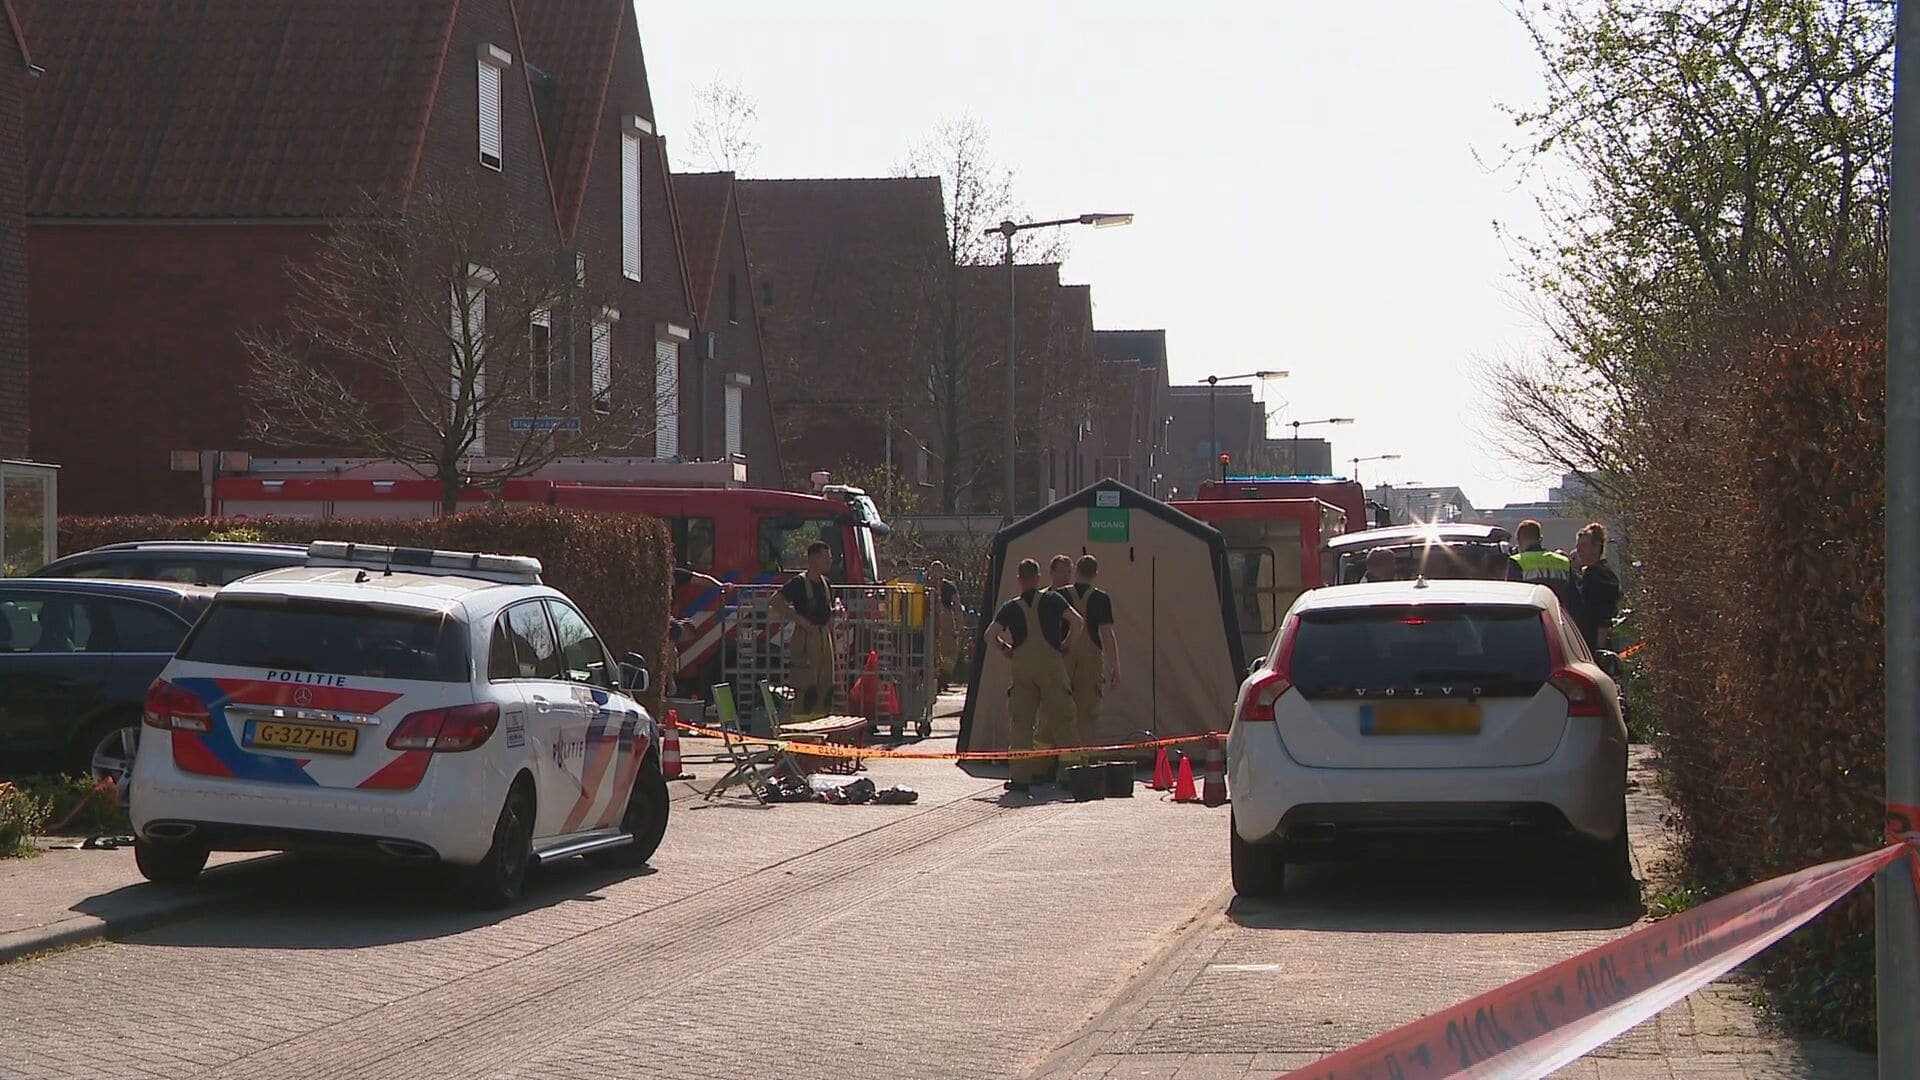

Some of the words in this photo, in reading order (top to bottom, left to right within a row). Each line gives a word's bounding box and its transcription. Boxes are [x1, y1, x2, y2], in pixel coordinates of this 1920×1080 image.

[1091, 521, 1125, 529] INGANG
[267, 670, 346, 687] POLITIE
[1355, 687, 1481, 696] VOLVO
[261, 725, 348, 748] G-327-HG
